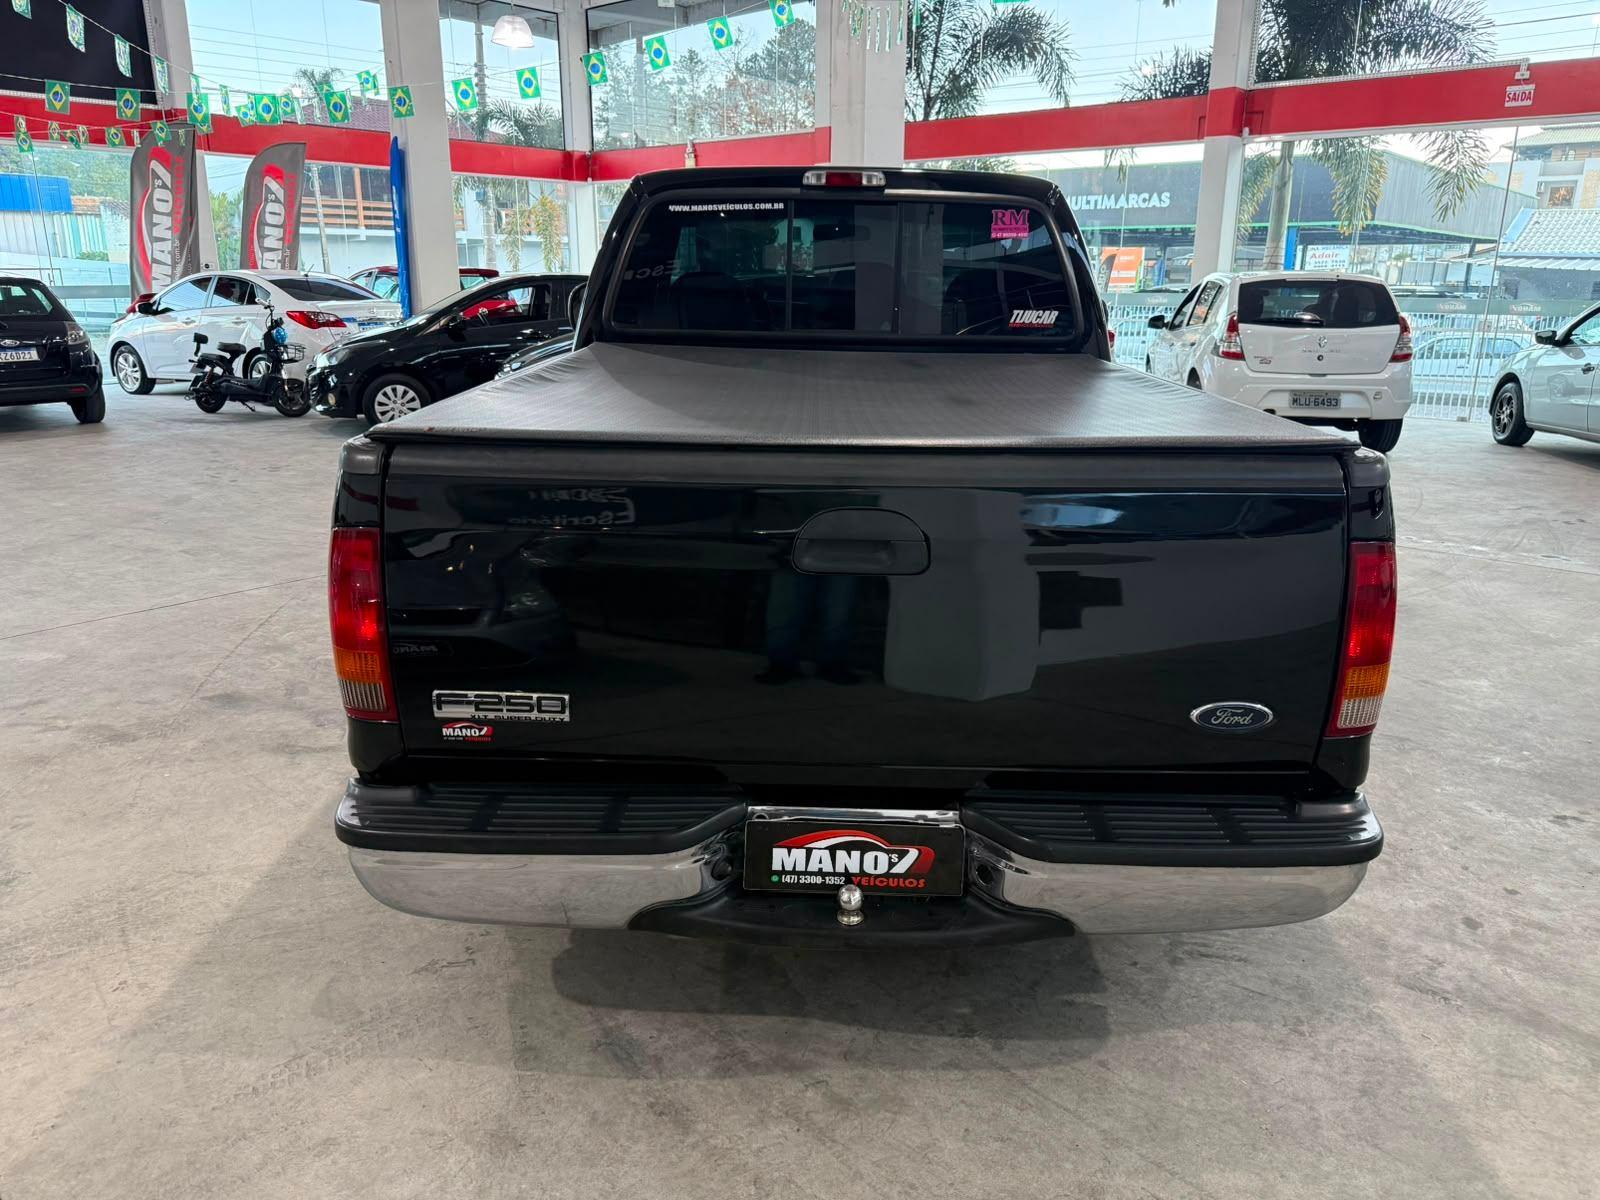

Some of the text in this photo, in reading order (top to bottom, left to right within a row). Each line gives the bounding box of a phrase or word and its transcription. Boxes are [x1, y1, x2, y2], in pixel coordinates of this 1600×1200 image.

[991, 208, 1030, 225] RM
[1210, 707, 1254, 725] Ford
[781, 875, 798, 885] (47)
[851, 875, 927, 888] VEÍCULOS
